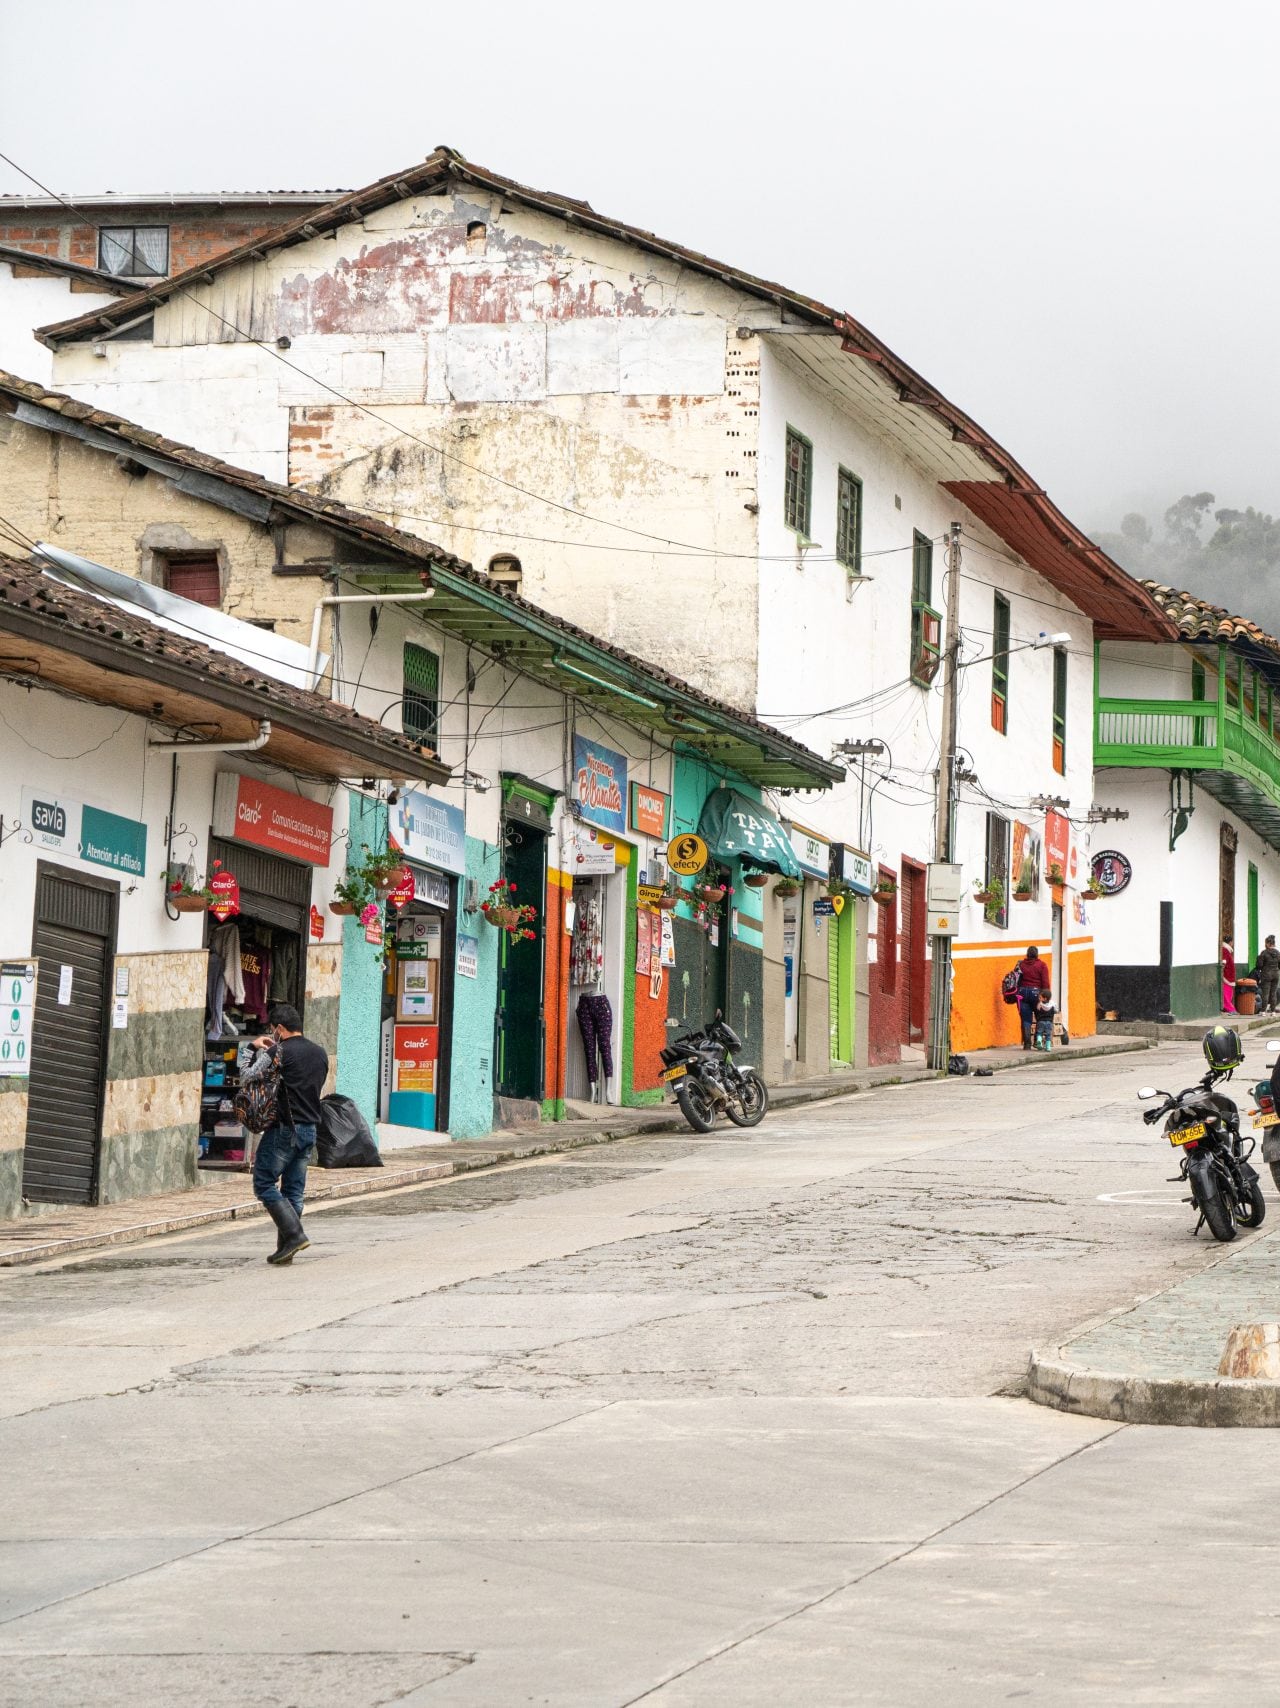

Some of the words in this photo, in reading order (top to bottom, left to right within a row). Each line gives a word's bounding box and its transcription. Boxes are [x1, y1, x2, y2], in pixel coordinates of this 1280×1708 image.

[238, 802, 259, 824] Claro
[272, 810, 314, 837] Comunicaciones
[314, 825, 329, 844] Jorge
[86, 842, 112, 862] Atención
[113, 851, 119, 865] al
[120, 853, 141, 871] afiliado
[673, 859, 700, 871] efecty
[212, 880, 232, 888] Claro
[639, 889, 660, 899] Giros
[403, 1040, 425, 1048] Claro
